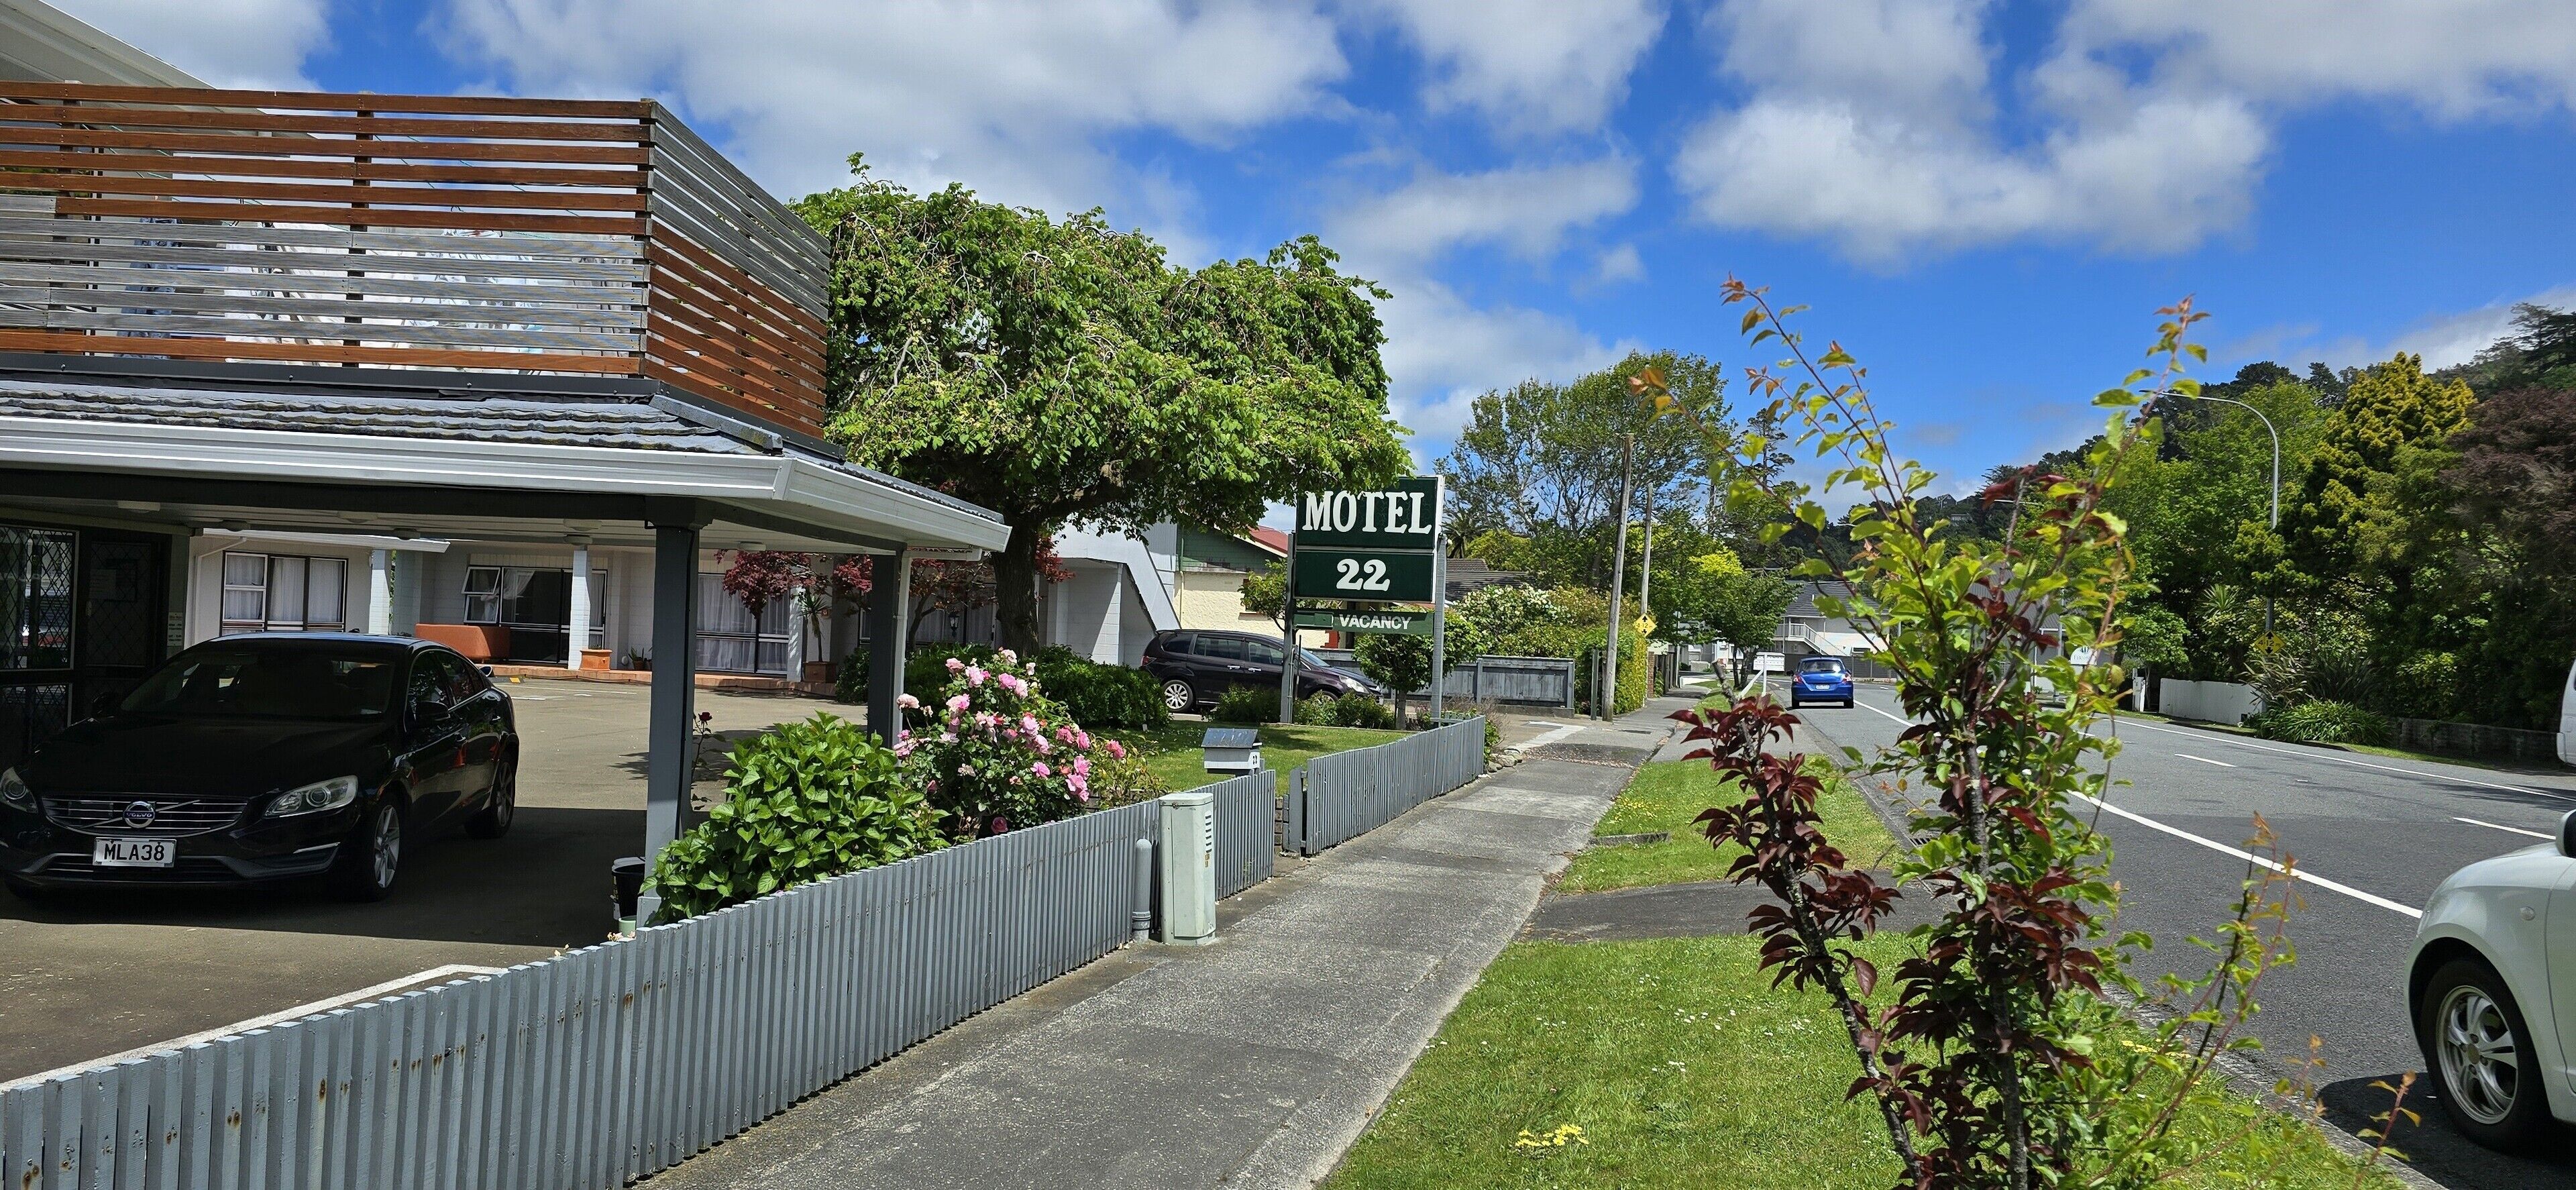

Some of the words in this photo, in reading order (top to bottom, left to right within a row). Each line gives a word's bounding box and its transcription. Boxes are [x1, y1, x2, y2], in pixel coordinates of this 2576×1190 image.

[1302, 490, 1432, 534] MOTEL
[1336, 558, 1391, 592] 22
[1339, 614, 1412, 629] VACANCY
[104, 843, 164, 861] MLA38
